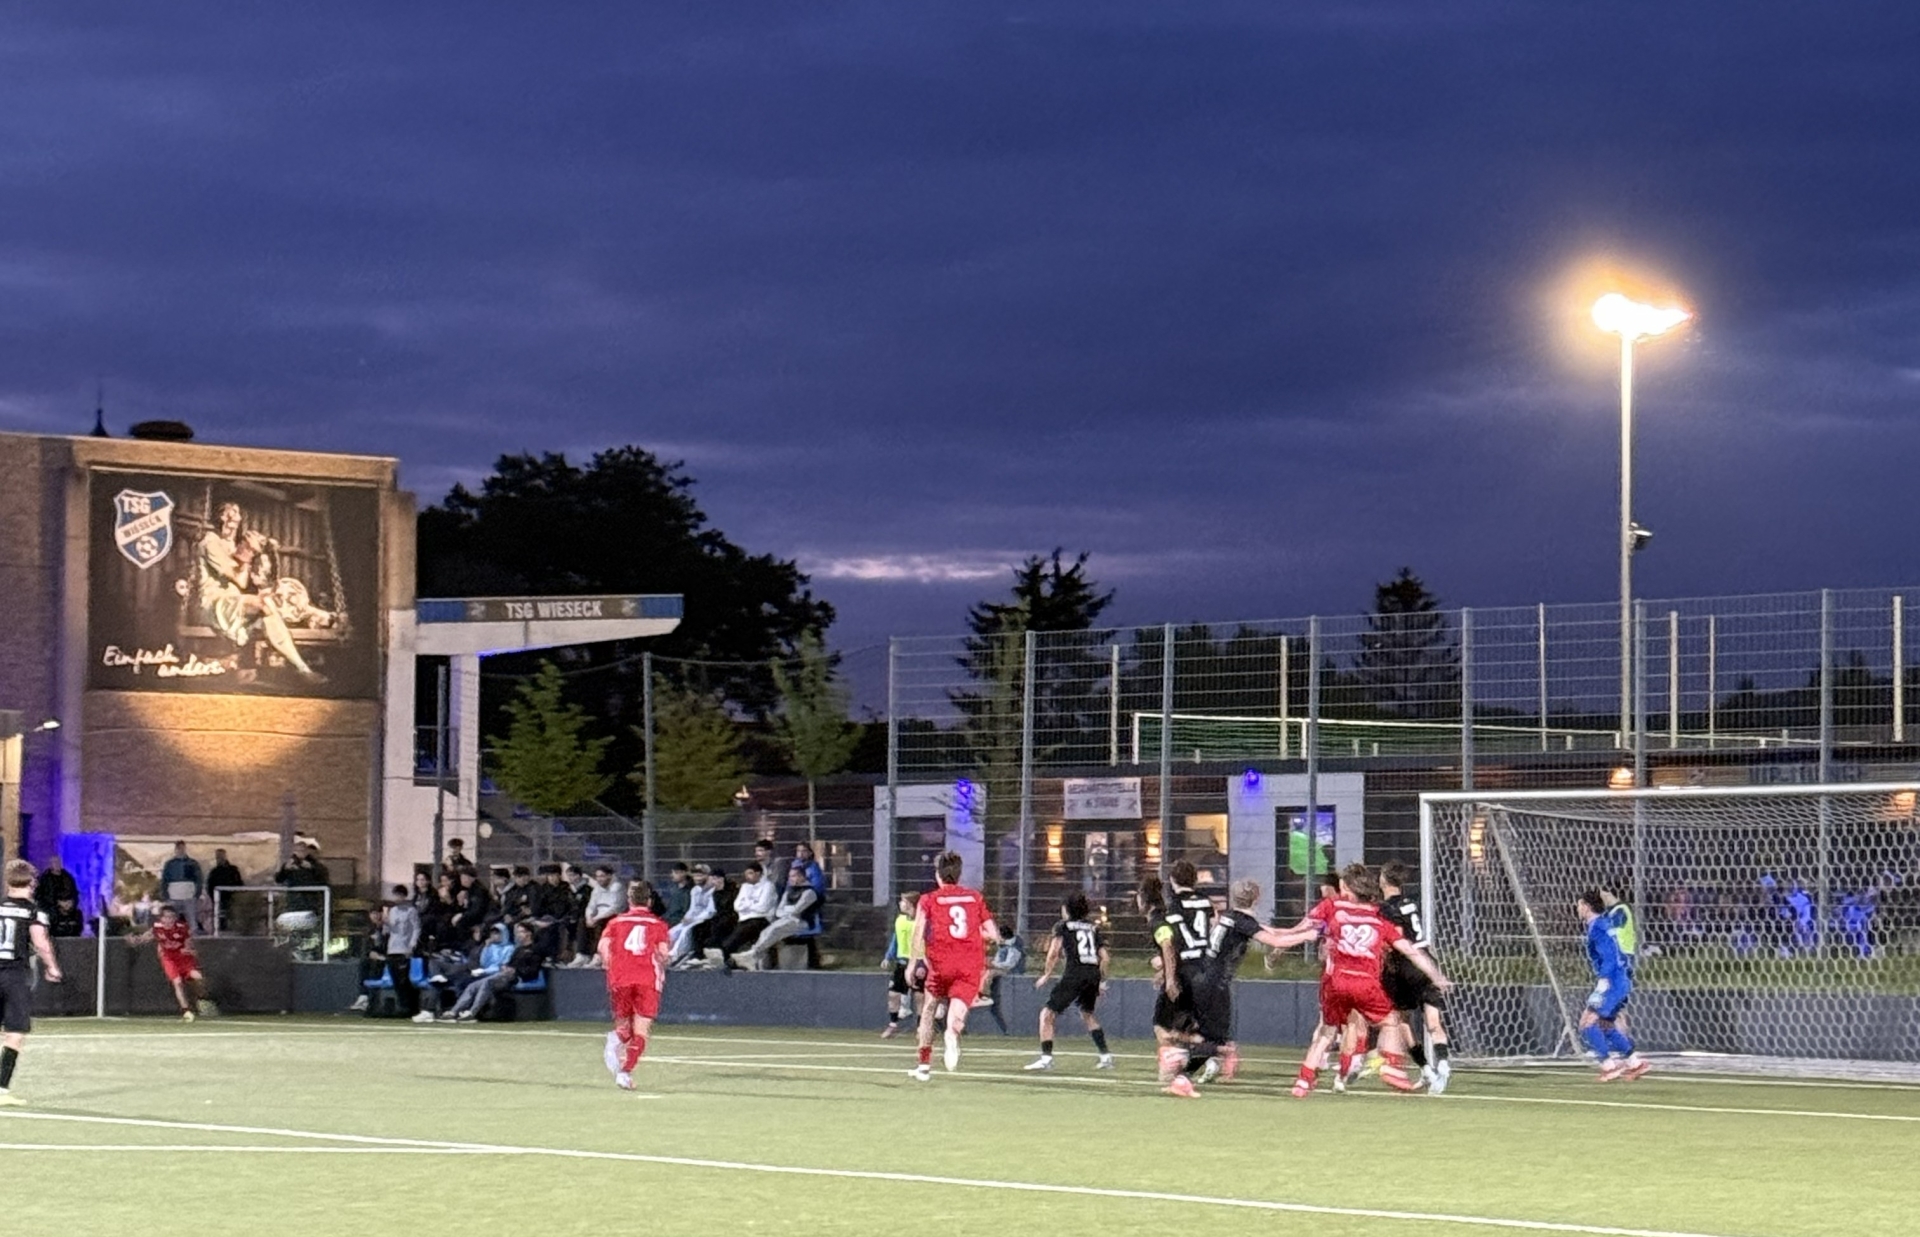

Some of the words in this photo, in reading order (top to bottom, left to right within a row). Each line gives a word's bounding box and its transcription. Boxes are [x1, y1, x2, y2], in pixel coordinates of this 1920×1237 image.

[120, 496, 151, 514] TSG
[505, 602, 534, 619] TSG
[537, 600, 602, 618] WIESECK
[948, 905, 968, 939] 3
[624, 924, 648, 956] 4
[1076, 930, 1096, 955] 21
